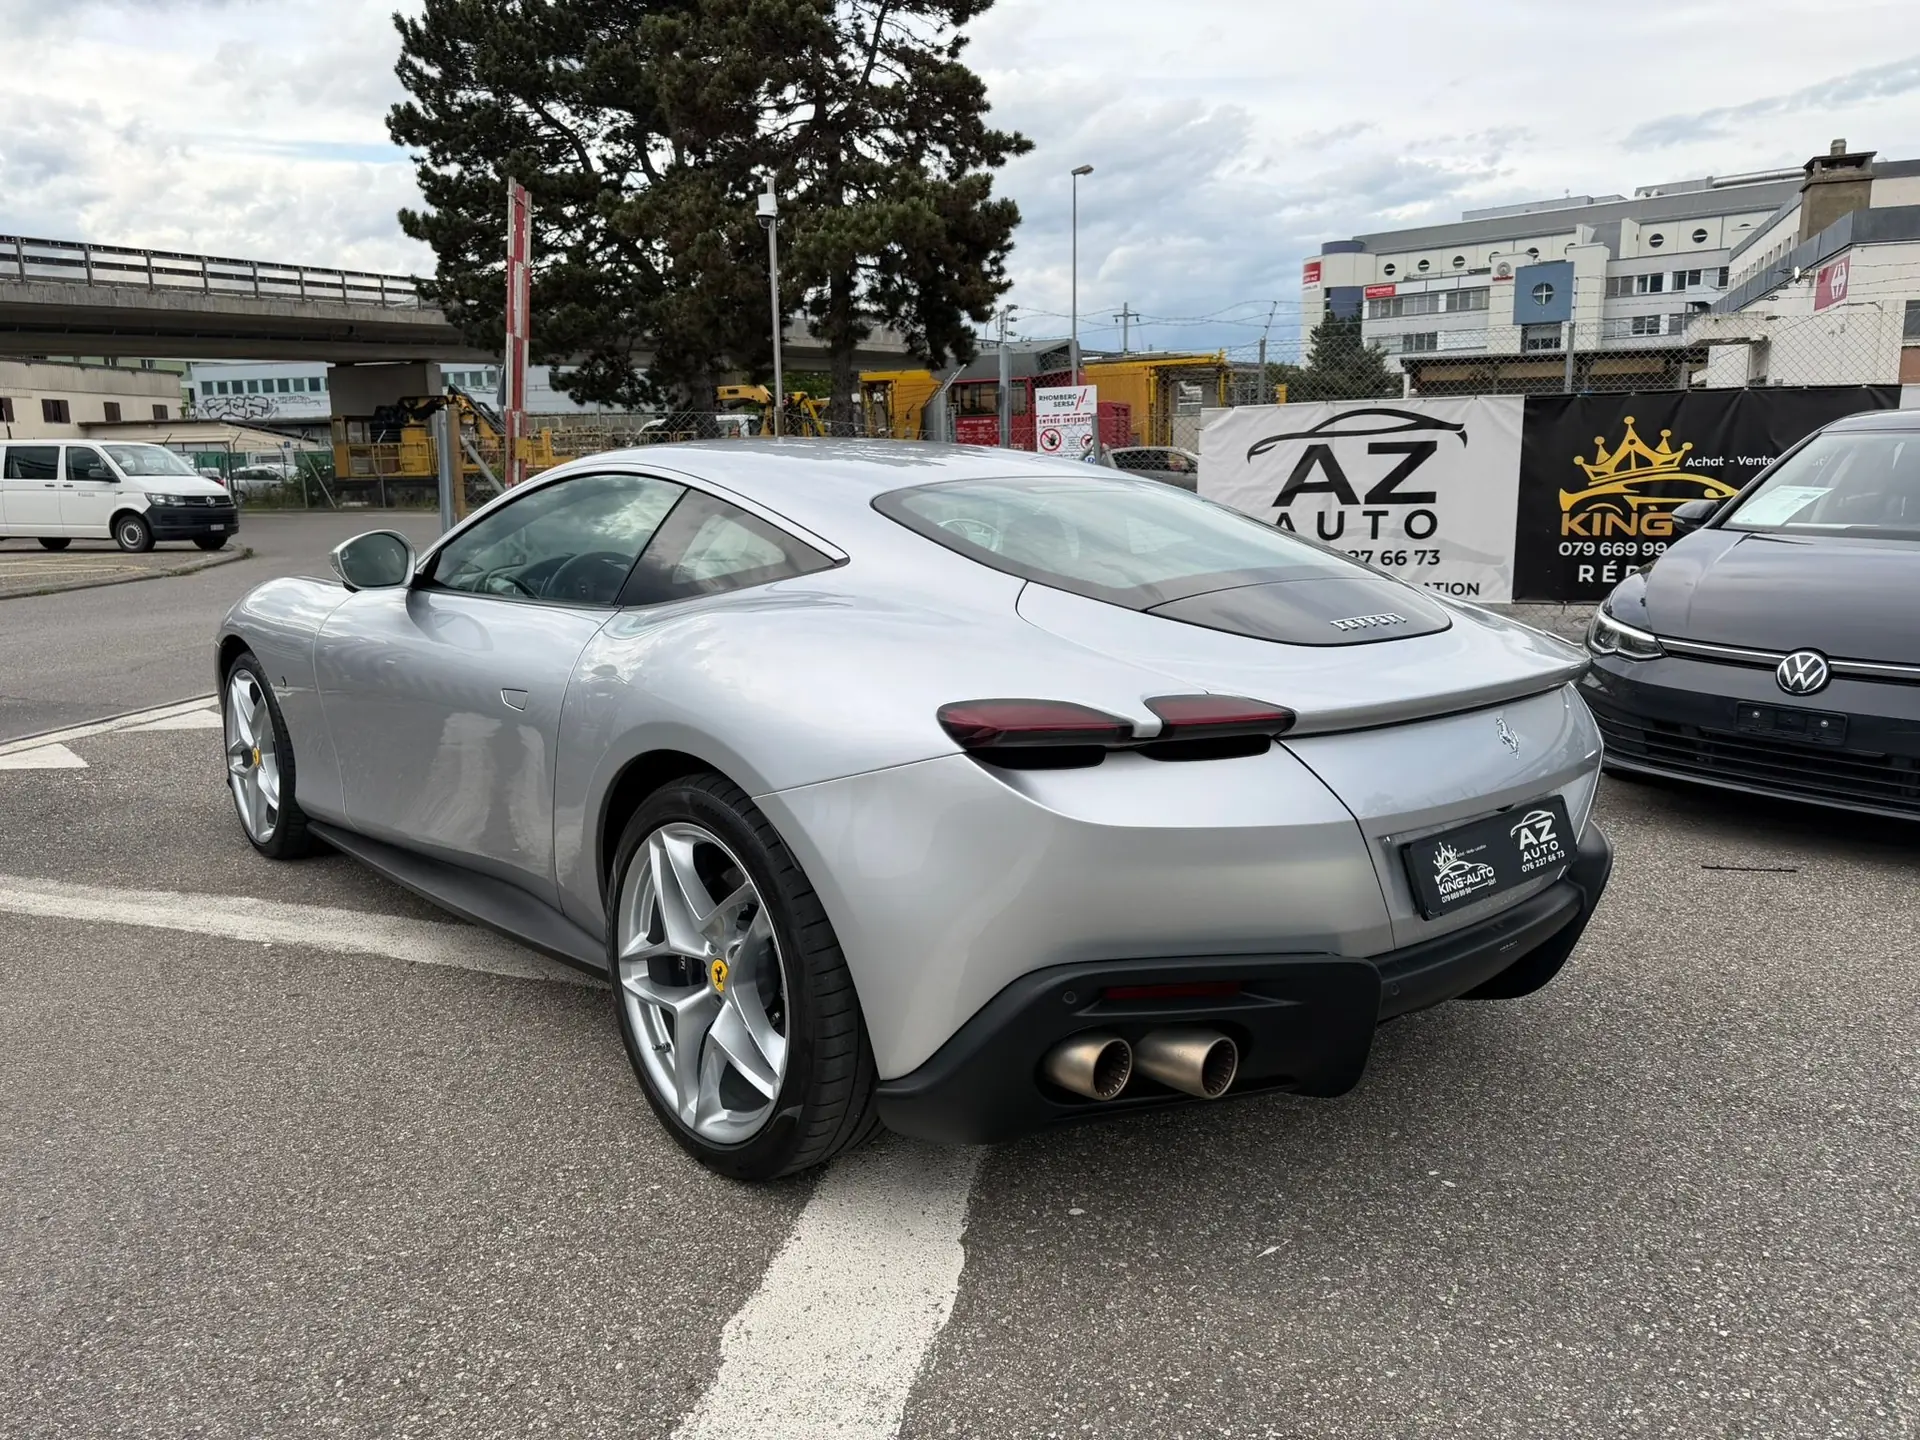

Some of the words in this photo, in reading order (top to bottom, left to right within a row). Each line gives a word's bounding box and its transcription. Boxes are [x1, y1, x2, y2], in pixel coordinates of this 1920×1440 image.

[1685, 456, 1725, 467] Achat
[1272, 440, 1438, 507] AZ
[1275, 509, 1438, 541] AUTO
[1561, 512, 1673, 536] KING
[1380, 550, 1407, 566] 66
[1414, 549, 1441, 566] 73
[1558, 542, 1595, 556] 079
[1600, 542, 1637, 556] 669
[1642, 542, 1667, 556] 99
[1423, 582, 1480, 596] TION
[1519, 819, 1557, 850] AZ
[1521, 862, 1535, 872] 076
[1535, 857, 1547, 868] 227
[1557, 850, 1565, 859] 73
[1523, 840, 1559, 862] AUTO
[1438, 866, 1494, 895] KING-AUTO
